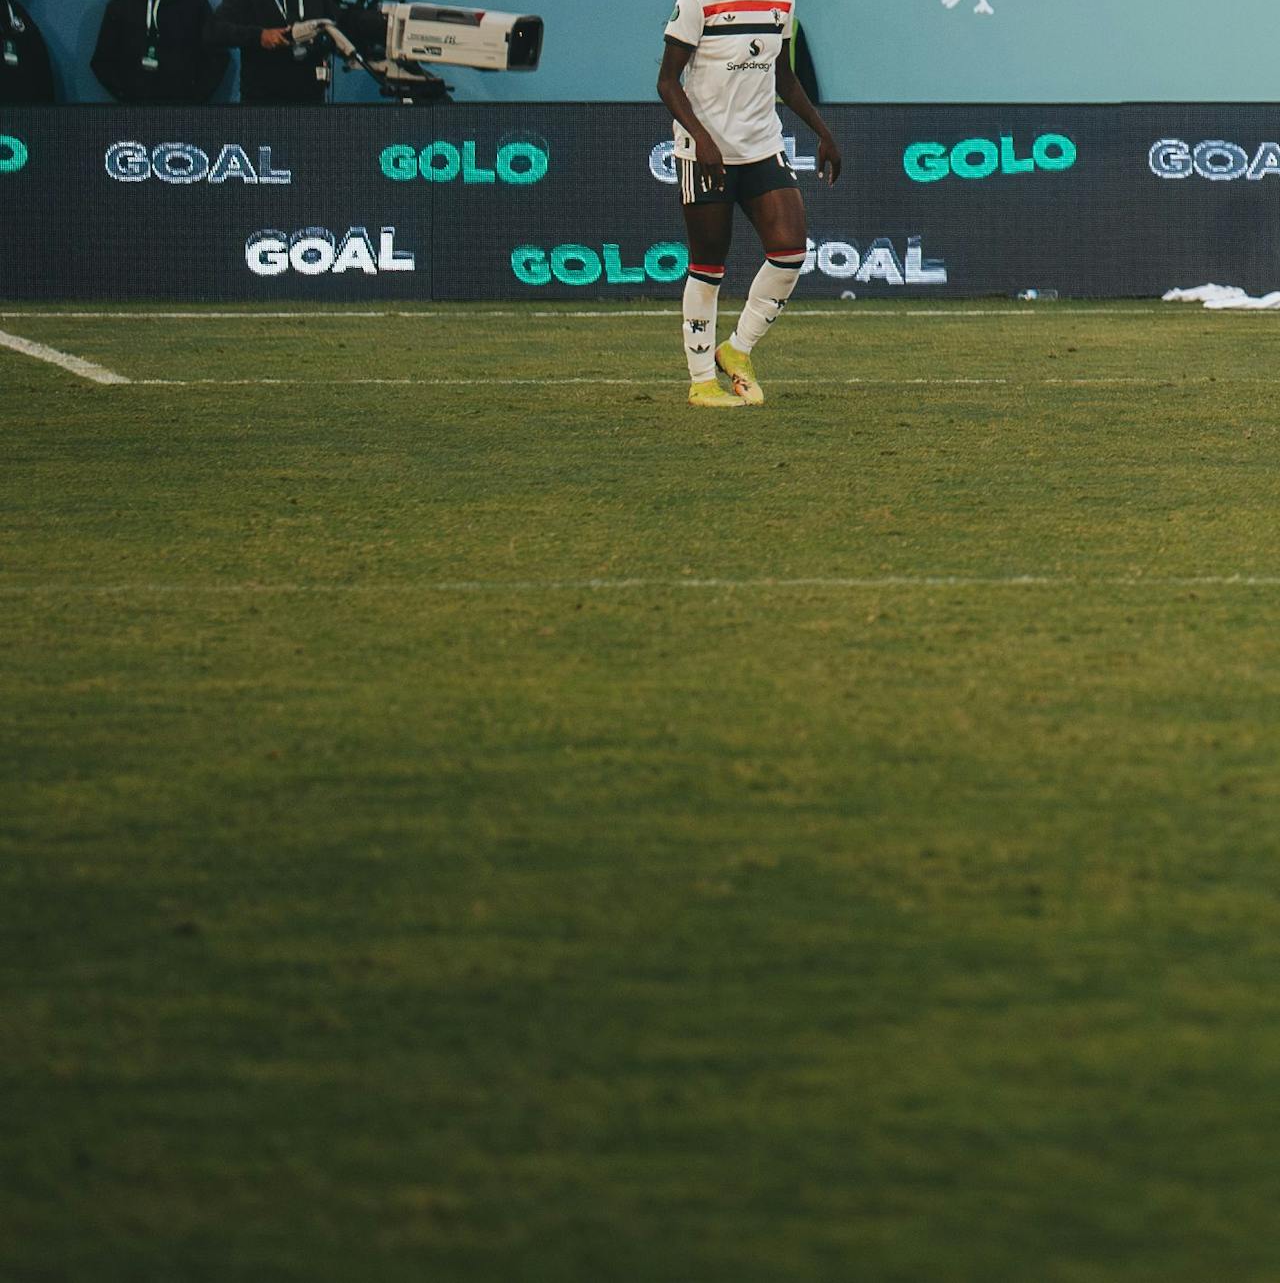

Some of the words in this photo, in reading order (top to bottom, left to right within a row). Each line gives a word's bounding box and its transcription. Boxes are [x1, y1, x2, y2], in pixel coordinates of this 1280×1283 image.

[105, 140, 291, 185] GOAL
[379, 136, 549, 186] GOLO
[903, 134, 1076, 183] GOLO
[245, 226, 416, 276] GOAL
[510, 241, 689, 286] GOLO
